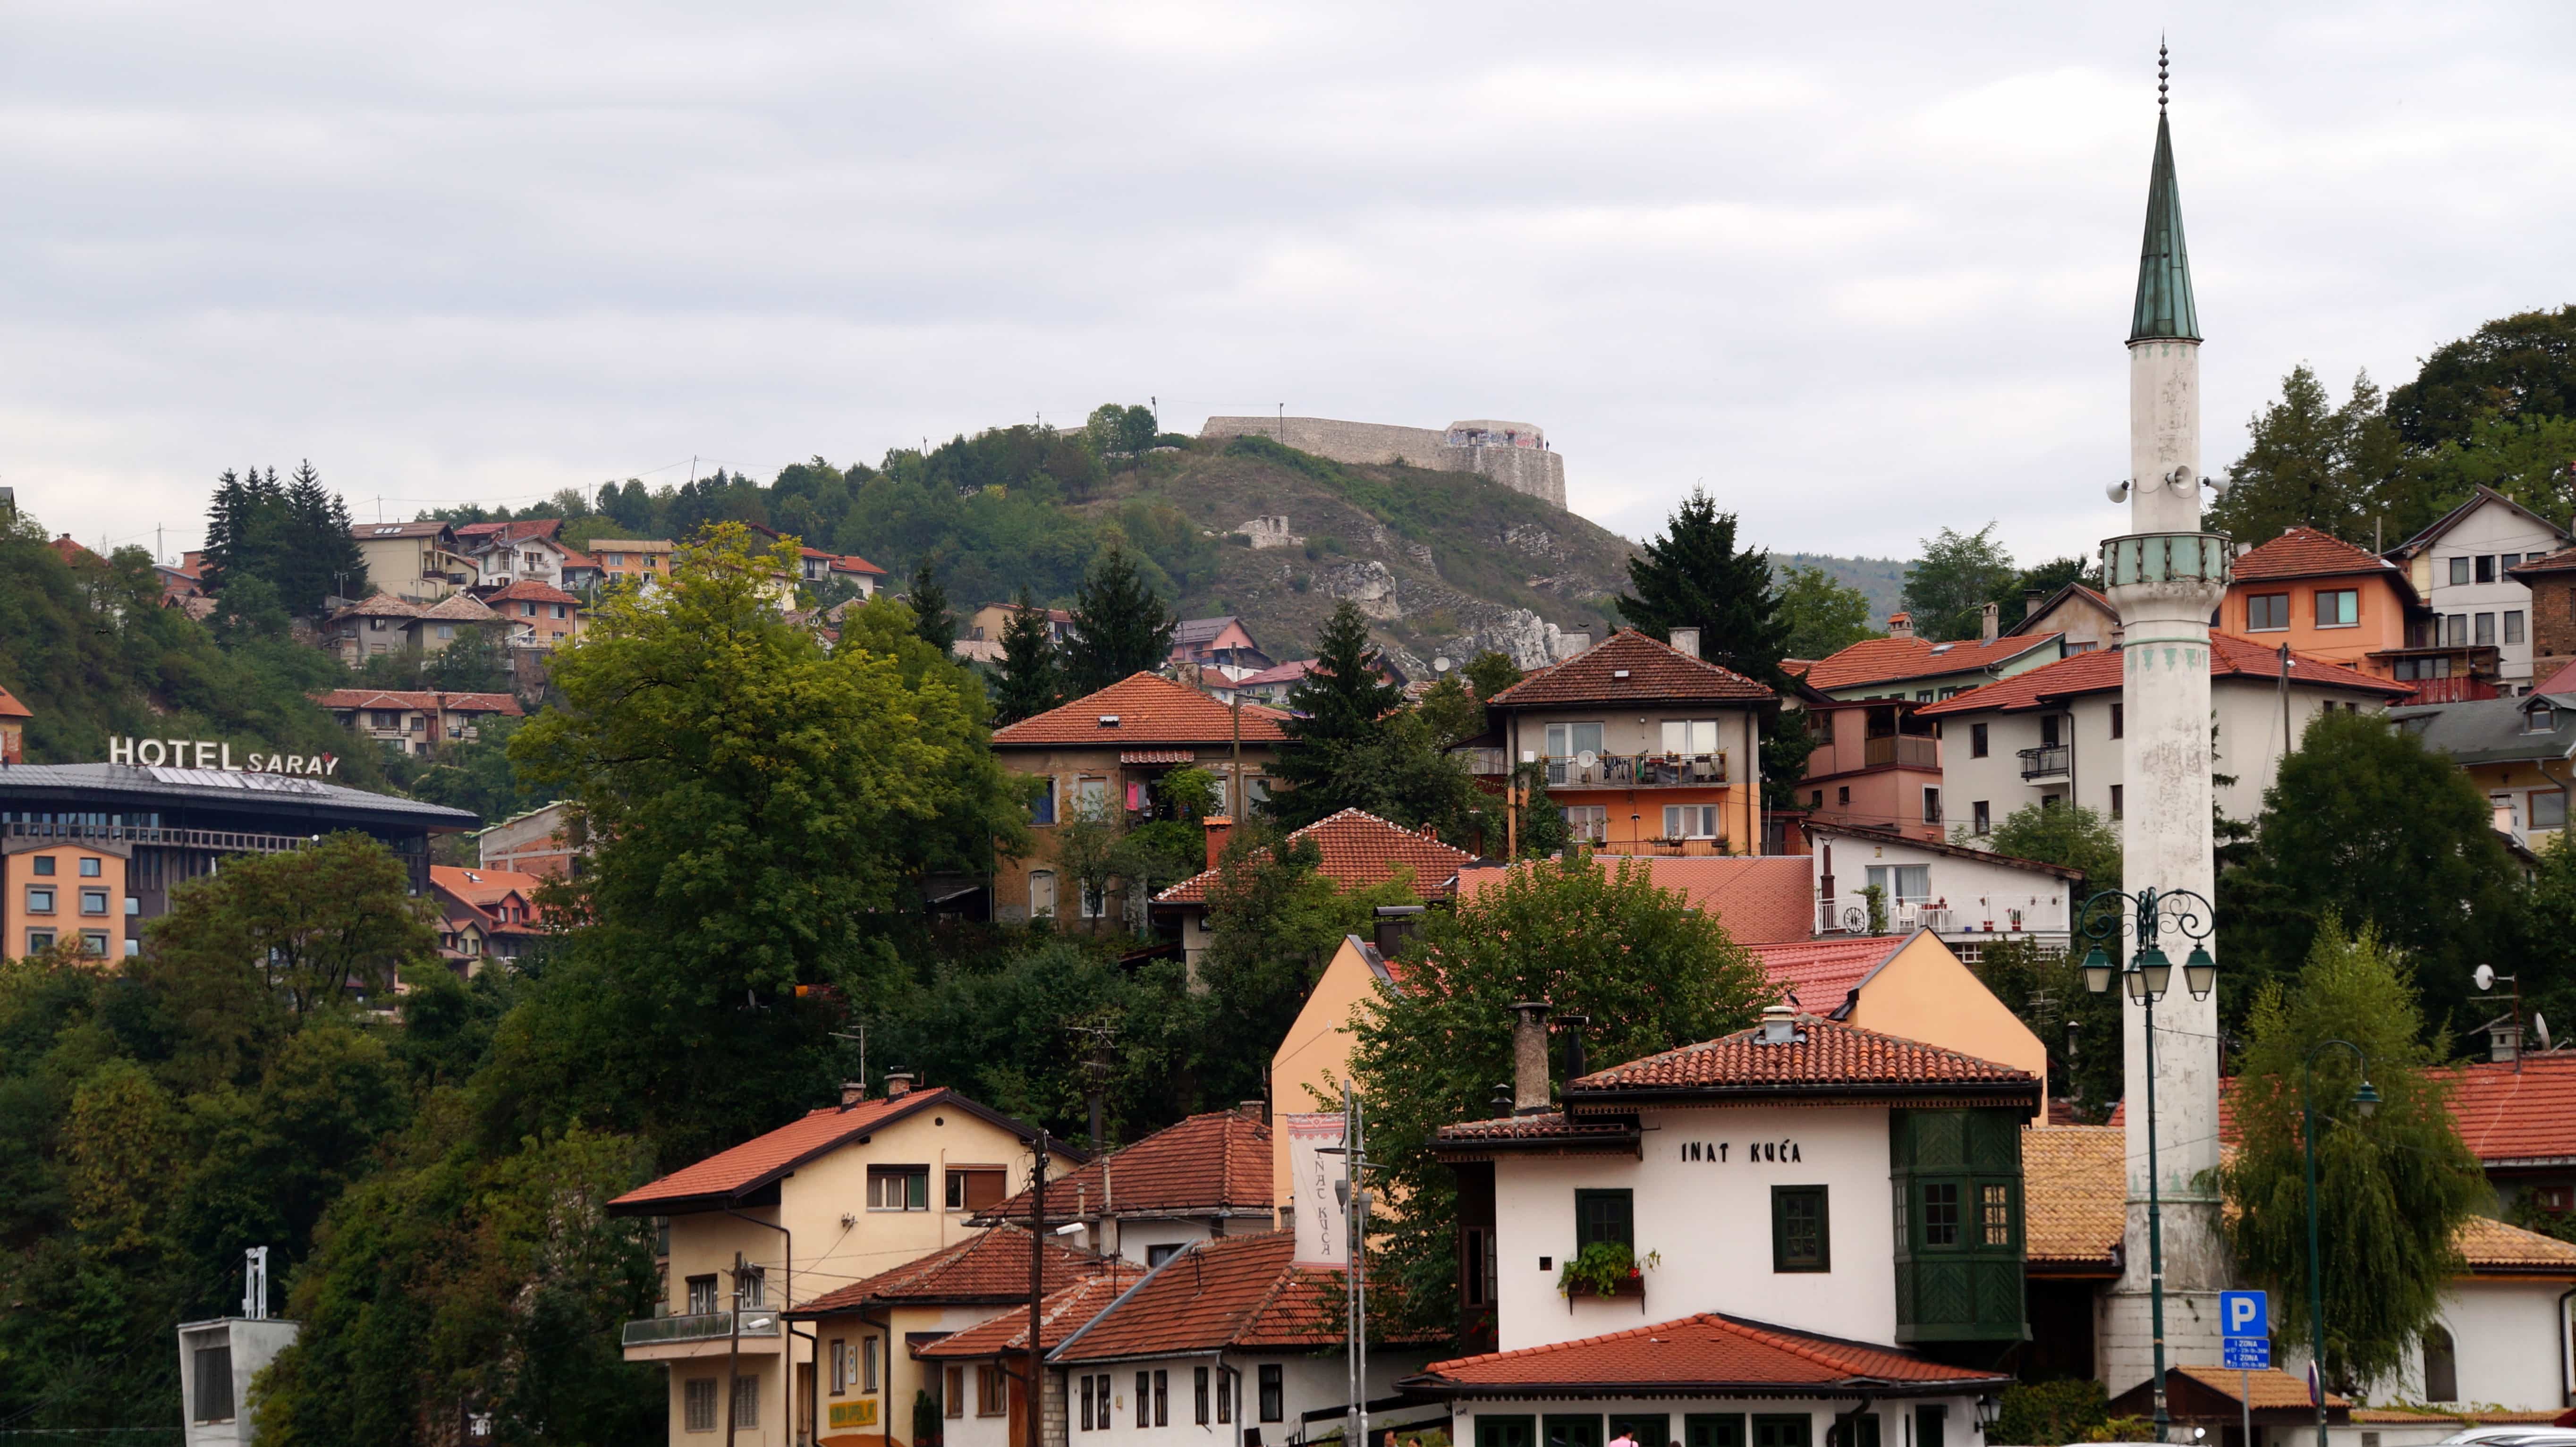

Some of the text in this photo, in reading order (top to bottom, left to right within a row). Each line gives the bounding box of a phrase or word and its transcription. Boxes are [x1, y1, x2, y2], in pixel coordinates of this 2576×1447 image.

[110, 736, 339, 776] HOTEL SARAY
[1681, 1138, 1801, 1163] INAT KUĆA
[2230, 1297, 2256, 1332] P
